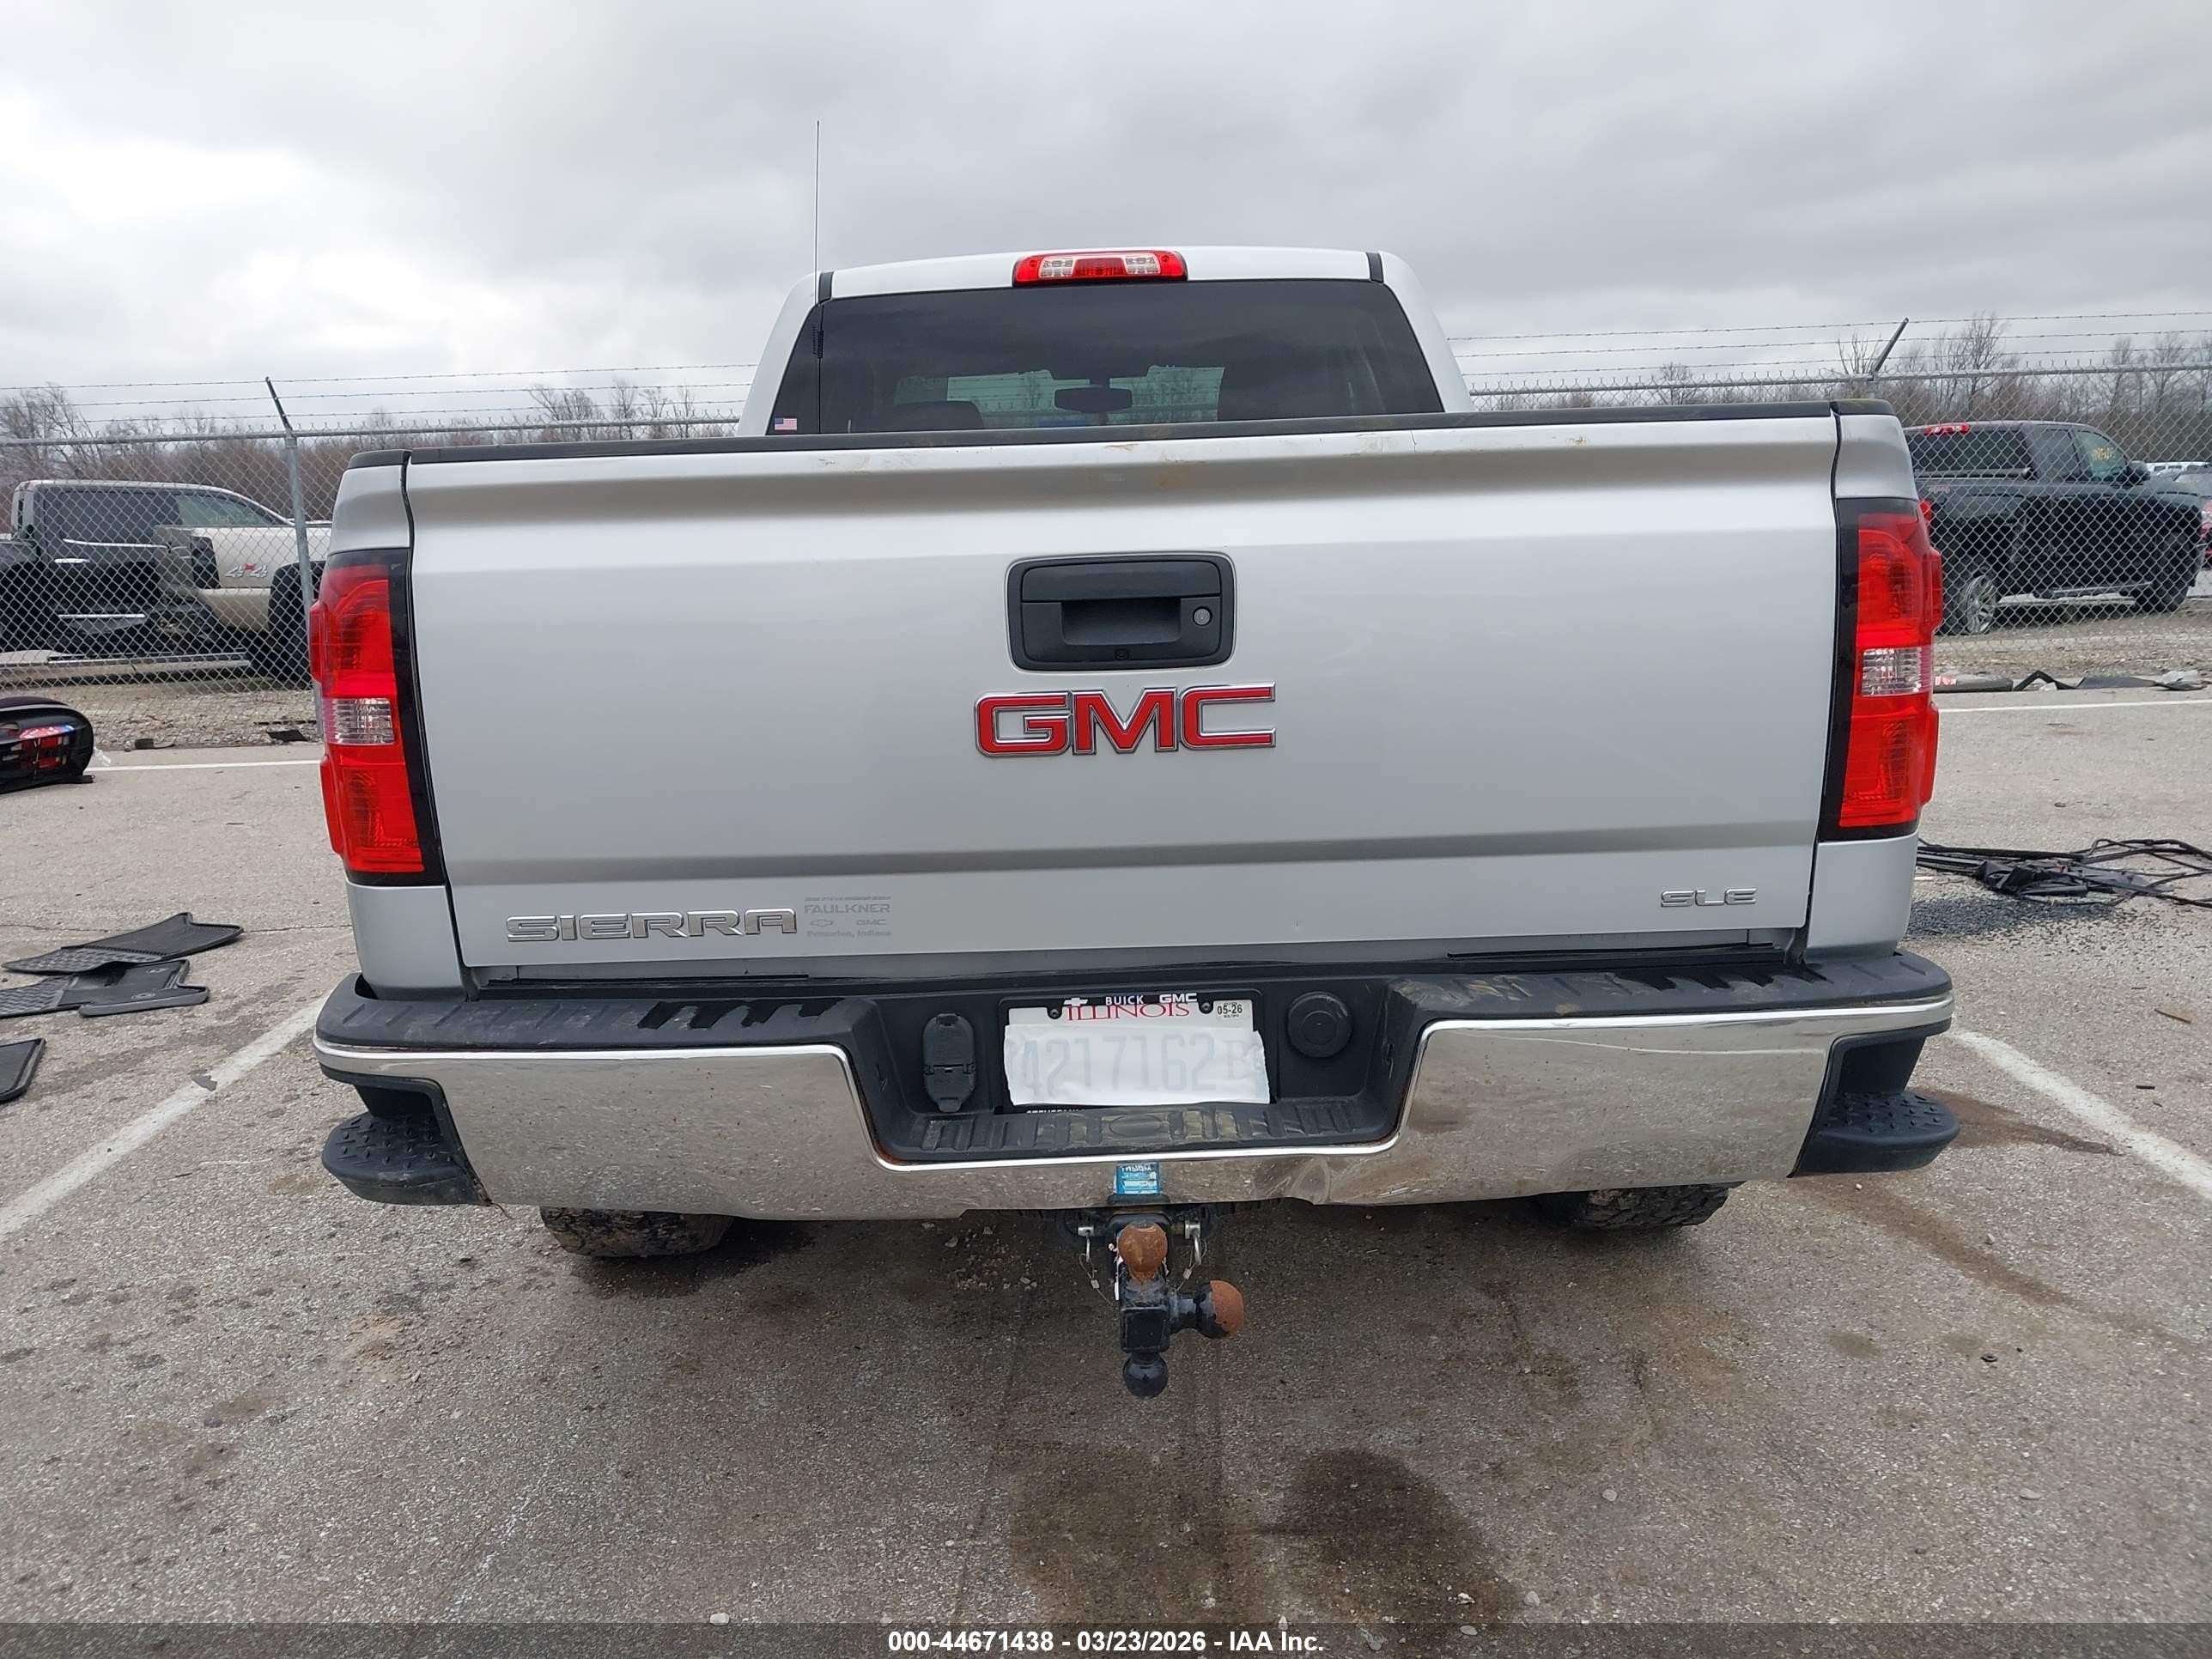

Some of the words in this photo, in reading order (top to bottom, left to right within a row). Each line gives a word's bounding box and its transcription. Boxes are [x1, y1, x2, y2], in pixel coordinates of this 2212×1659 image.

[975, 681, 1276, 757] GMC
[1660, 887, 1757, 908] SLE
[804, 903, 890, 914] FAULKNER
[506, 908, 798, 942] SIERRA
[1105, 995, 1146, 1006] BUICK
[1159, 993, 1198, 1004] GMC
[1217, 1003, 1243, 1015] 05-26
[1067, 1002, 1191, 1022] ILLINOIS
